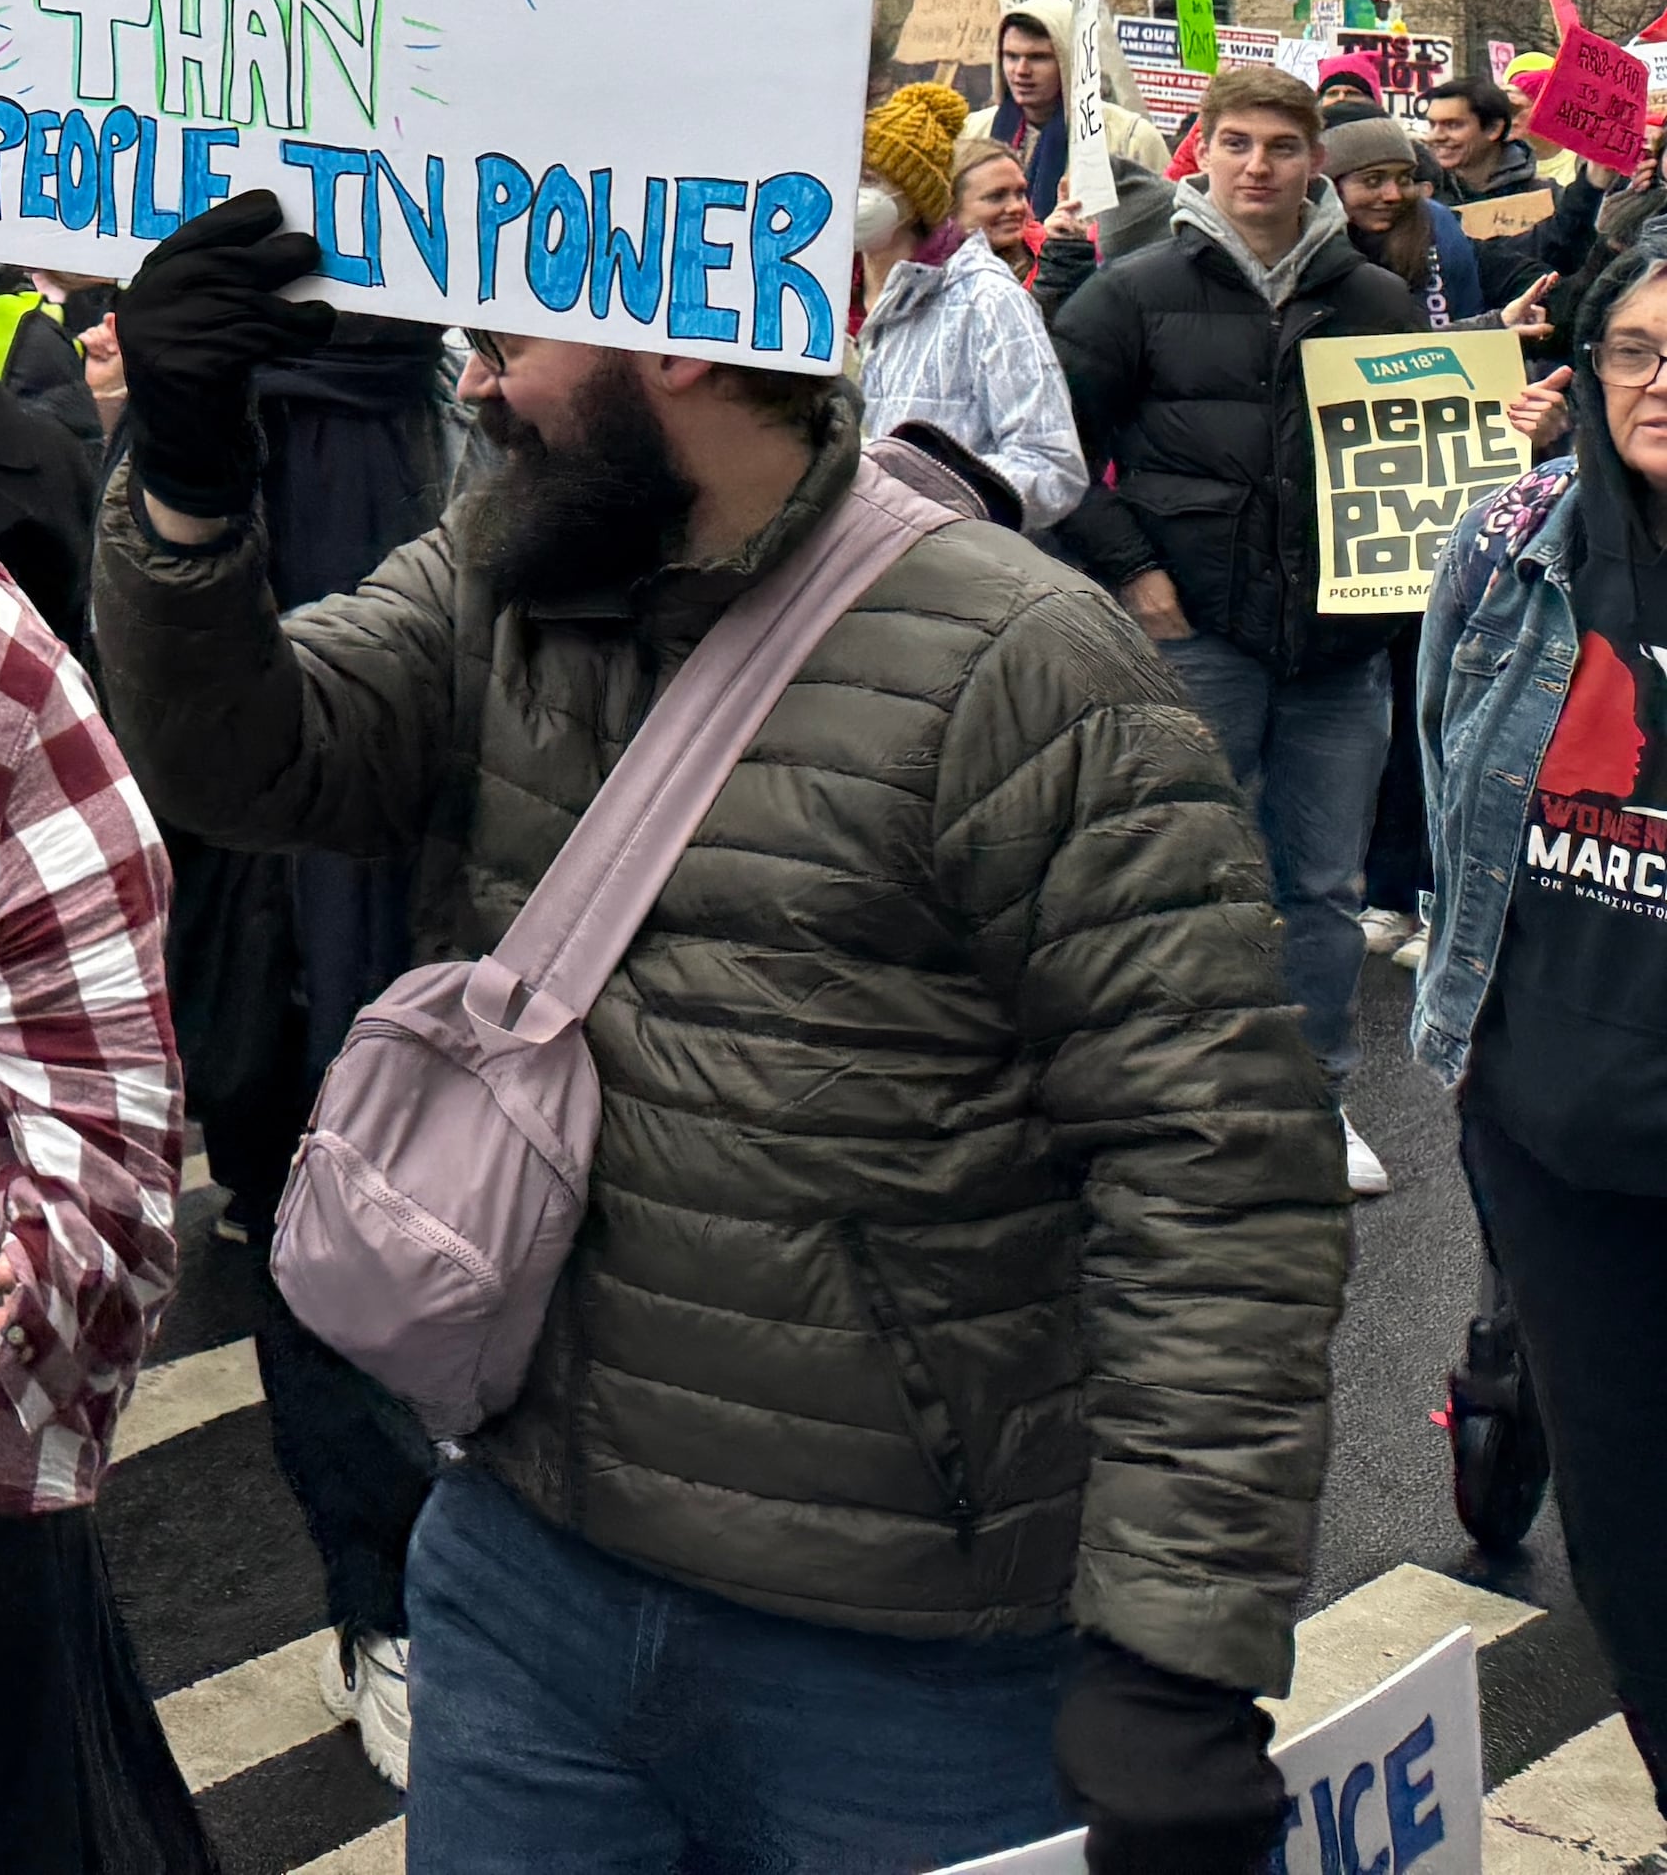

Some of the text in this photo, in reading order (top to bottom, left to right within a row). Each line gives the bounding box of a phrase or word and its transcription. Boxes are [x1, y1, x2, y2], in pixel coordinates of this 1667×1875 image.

[1120, 25, 1176, 43] IN OUR
[1230, 44, 1275, 59] WINS
[1412, 39, 1452, 65] IS
[278, 137, 450, 302] IN
[475, 151, 835, 361] POWER
[1373, 359, 1409, 378] JAN
[1330, 482, 1508, 579] POWE
[1329, 584, 1404, 599] PEOPLE'S
[1526, 824, 1667, 899] MARC
[1574, 884, 1667, 922] WASHINGTO
